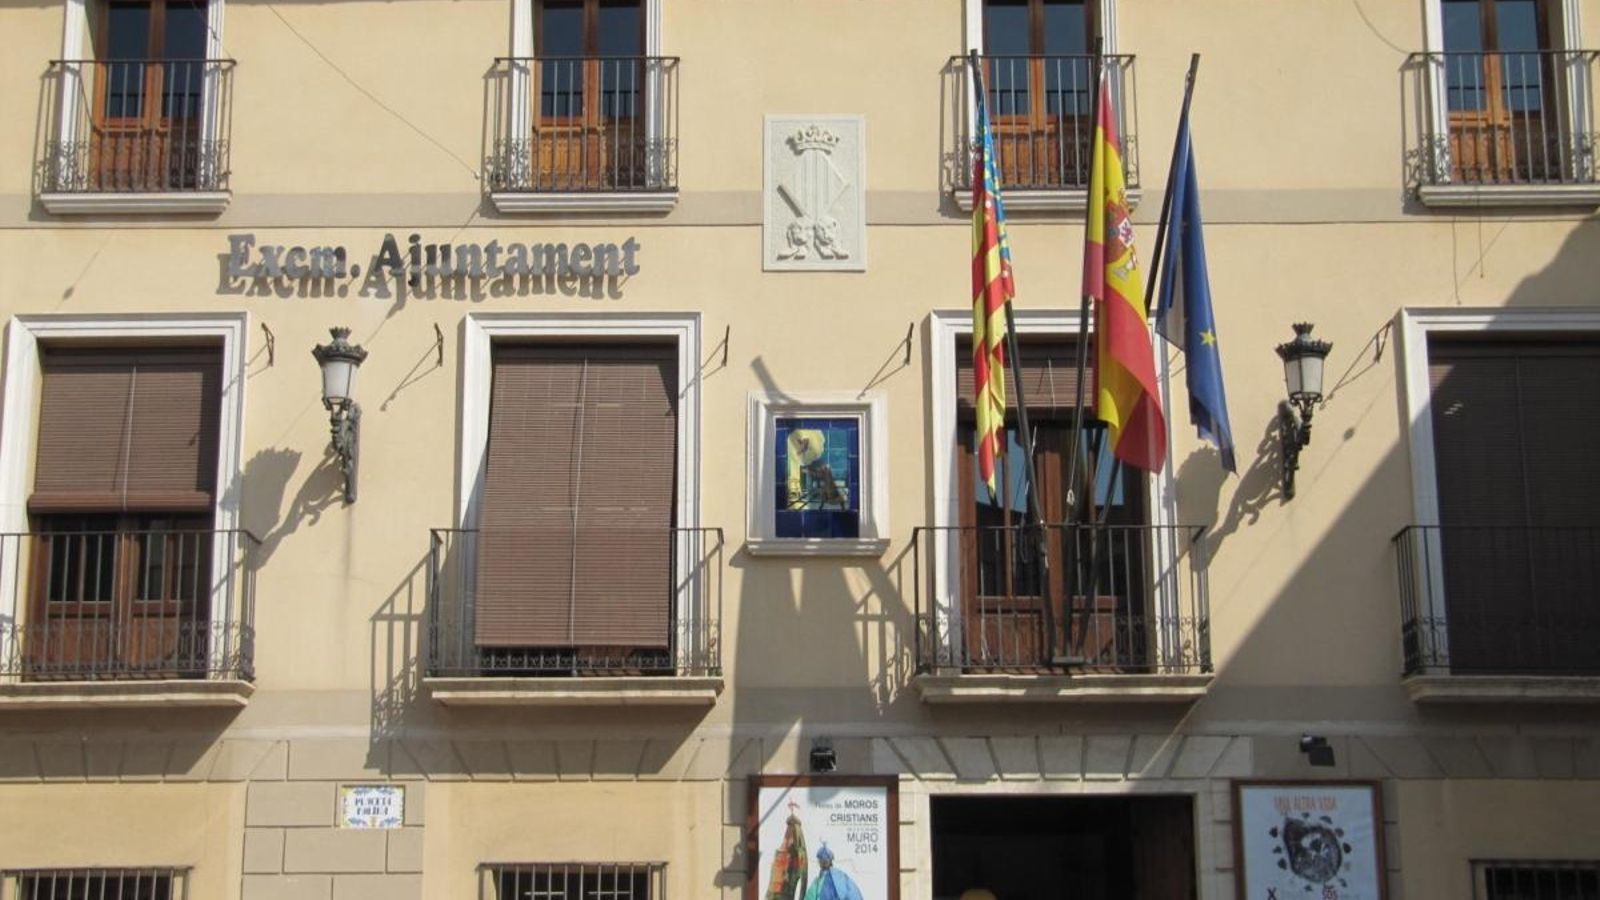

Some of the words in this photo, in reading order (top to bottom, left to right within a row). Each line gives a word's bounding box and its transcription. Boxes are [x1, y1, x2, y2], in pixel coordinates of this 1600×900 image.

[227, 233, 360, 278] Excm.
[375, 232, 638, 287] Ajuntament
[844, 800, 879, 809] MOROS
[830, 813, 879, 823] CRISTIANS
[847, 832, 879, 843] MURO
[854, 843, 879, 854] 2014
